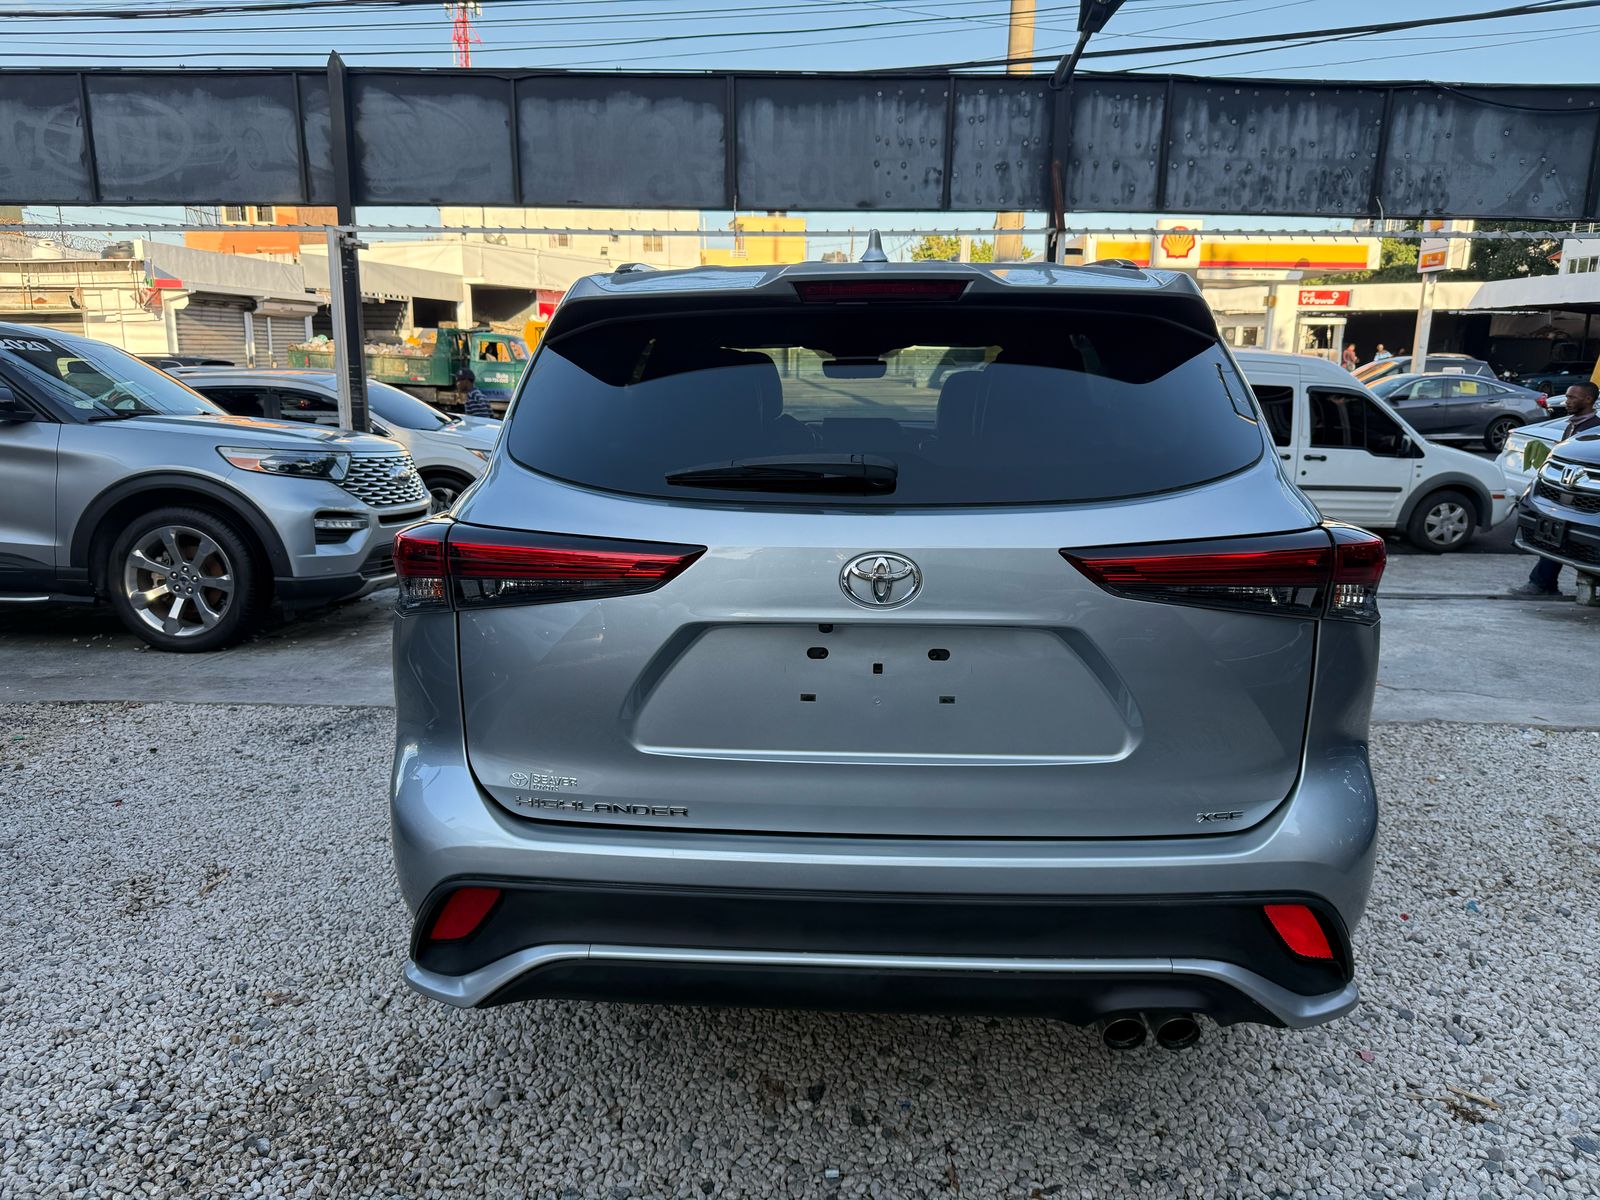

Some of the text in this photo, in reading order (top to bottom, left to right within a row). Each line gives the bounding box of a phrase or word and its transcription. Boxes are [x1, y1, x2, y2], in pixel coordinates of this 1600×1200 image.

[1301, 297, 1337, 305] V-Power
[532, 773, 578, 787] BEAVER
[514, 795, 689, 817] HIGHLANDER
[1195, 810, 1245, 824] XSE
